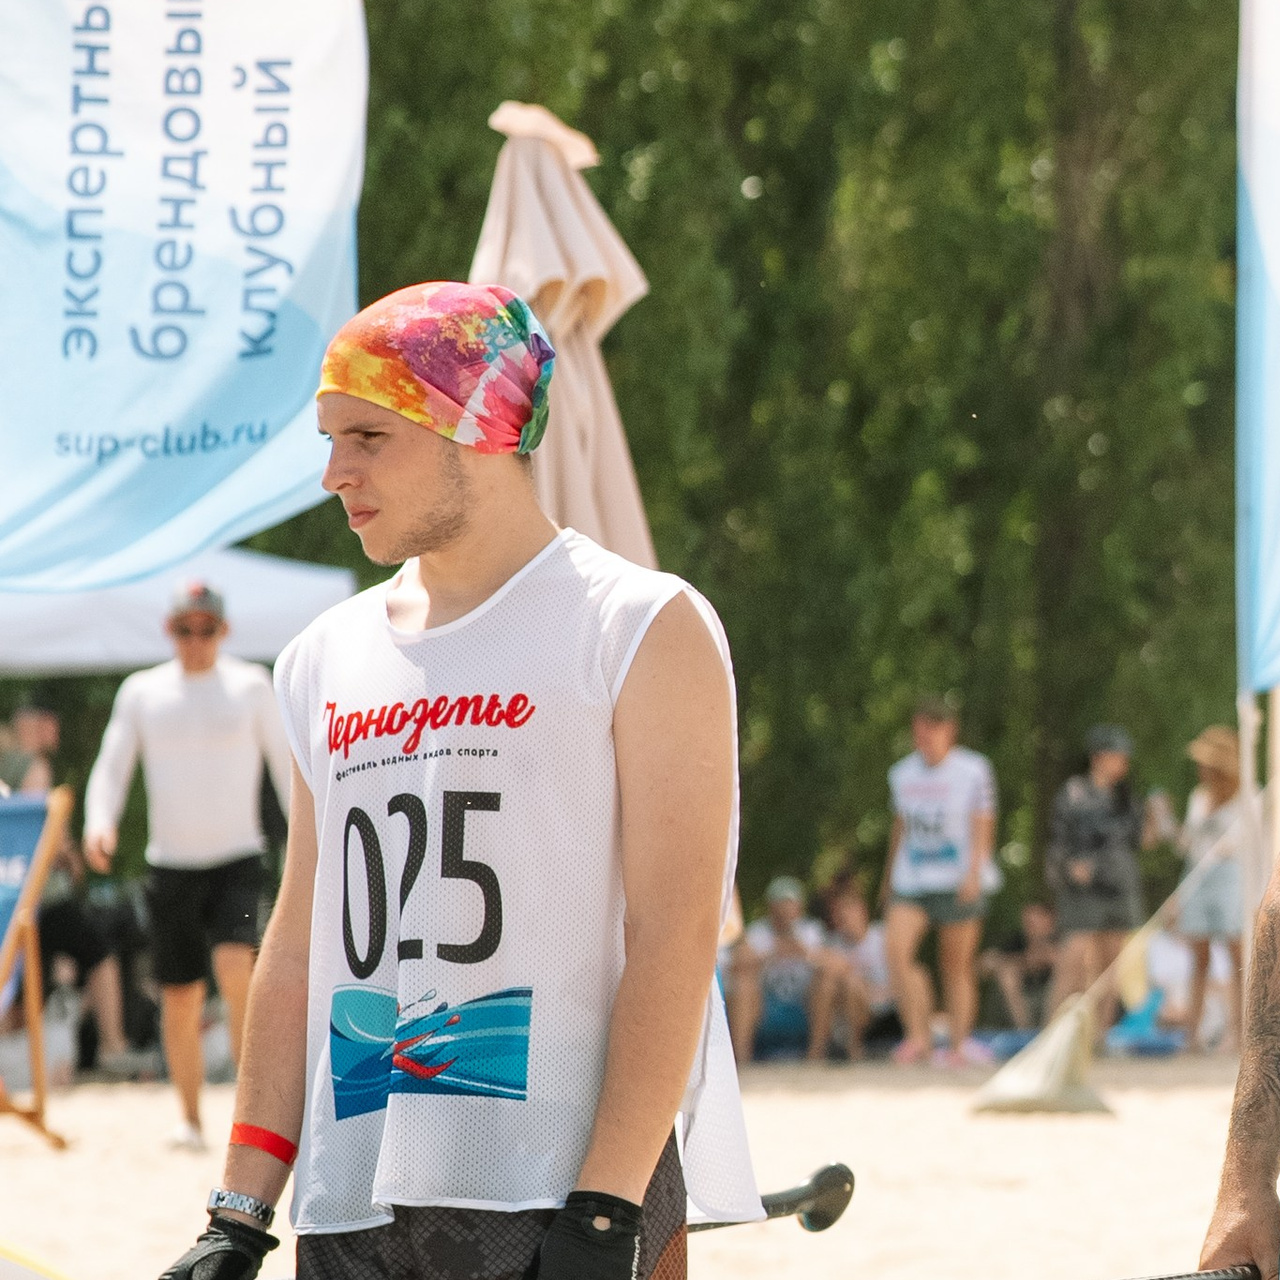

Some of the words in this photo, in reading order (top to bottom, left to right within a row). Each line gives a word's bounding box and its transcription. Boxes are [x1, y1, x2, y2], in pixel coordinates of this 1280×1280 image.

[229, 58, 295, 361] клубный
[54, 420, 268, 466] sup-club.ru
[323, 692, 536, 760] Черноземье
[336, 760, 378, 782] фестиваль
[381, 754, 419, 767] водных
[423, 748, 452, 760] видов
[457, 748, 499, 758] спорта
[342, 790, 503, 980] 025
